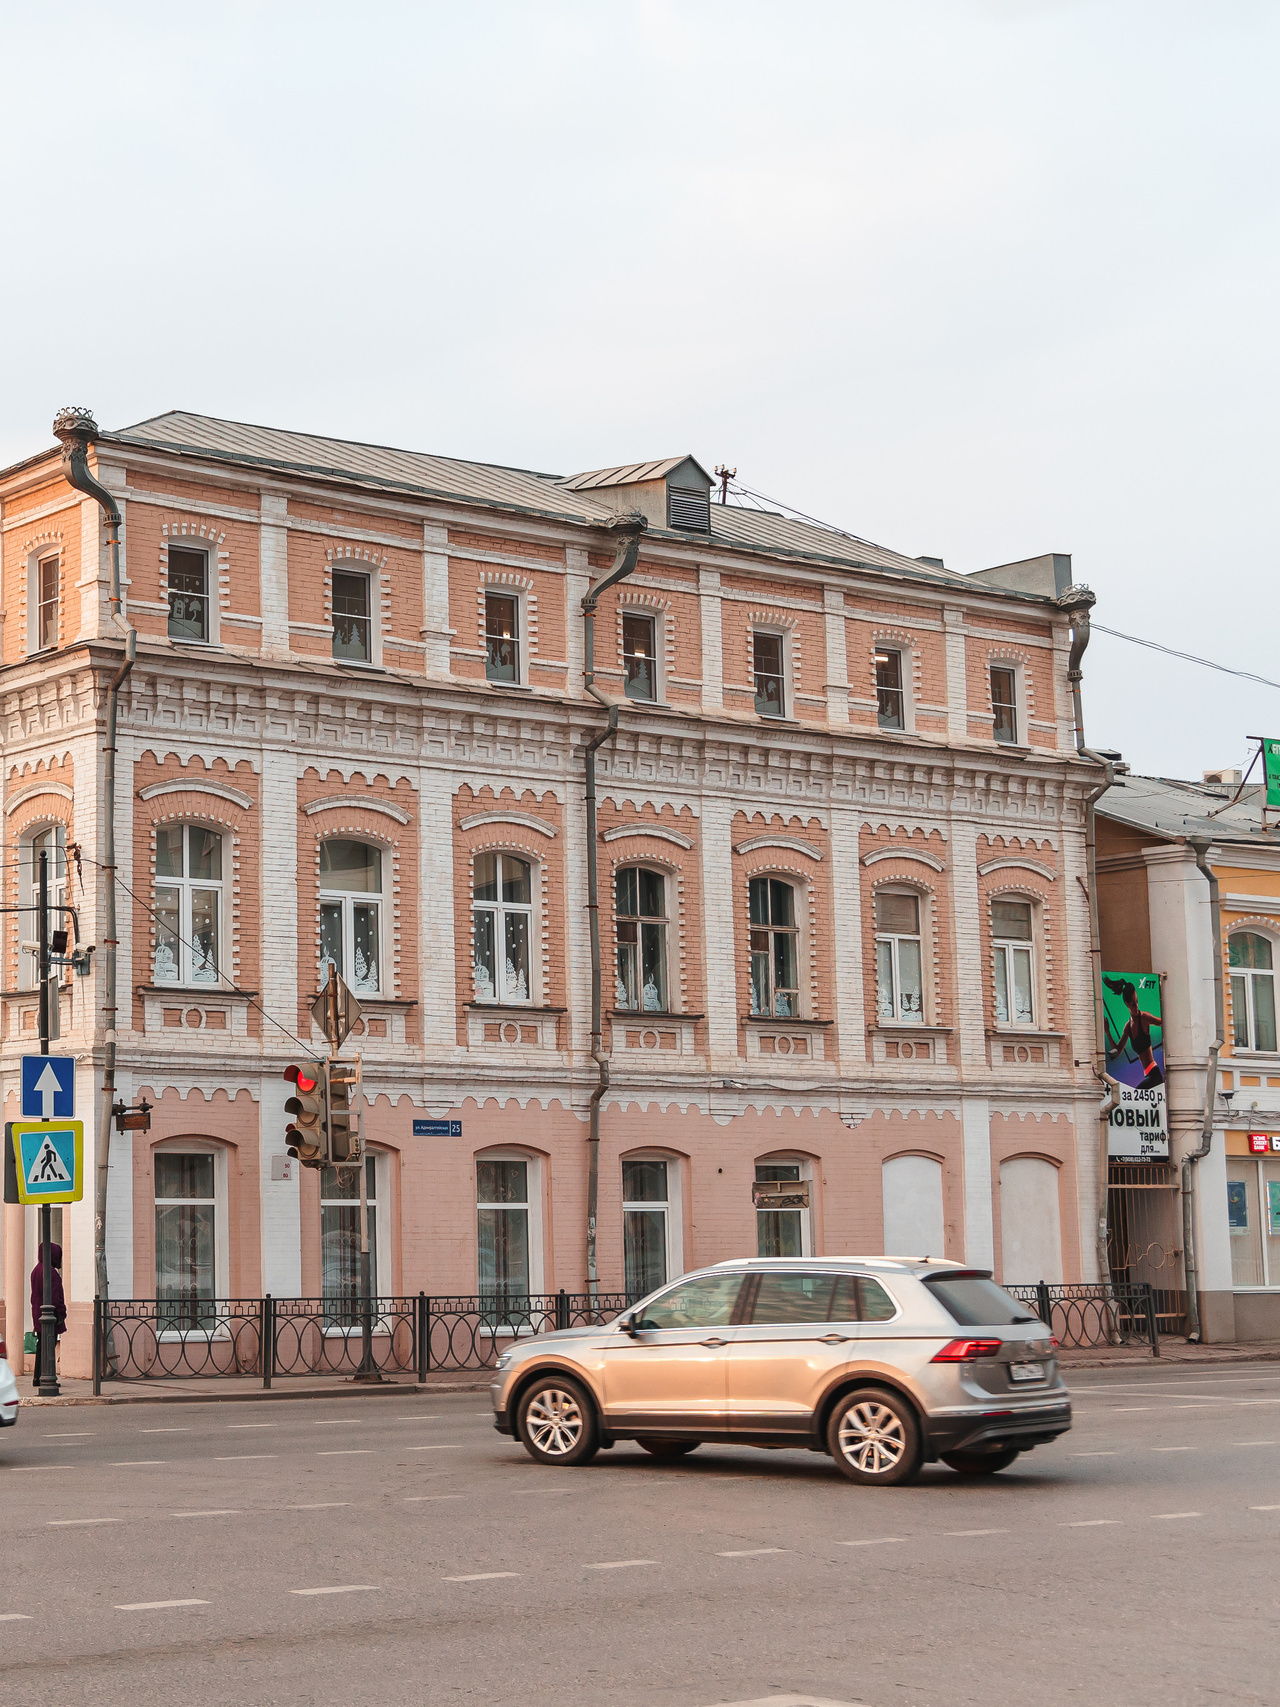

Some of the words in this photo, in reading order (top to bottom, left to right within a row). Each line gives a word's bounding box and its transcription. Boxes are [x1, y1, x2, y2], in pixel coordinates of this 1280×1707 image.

[1138, 976, 1156, 989] XFIT
[1122, 1091, 1132, 1101] за
[1134, 1089, 1155, 1101] 2450
[452, 1124, 461, 1133] 25
[1140, 1129, 1167, 1144] тариф
